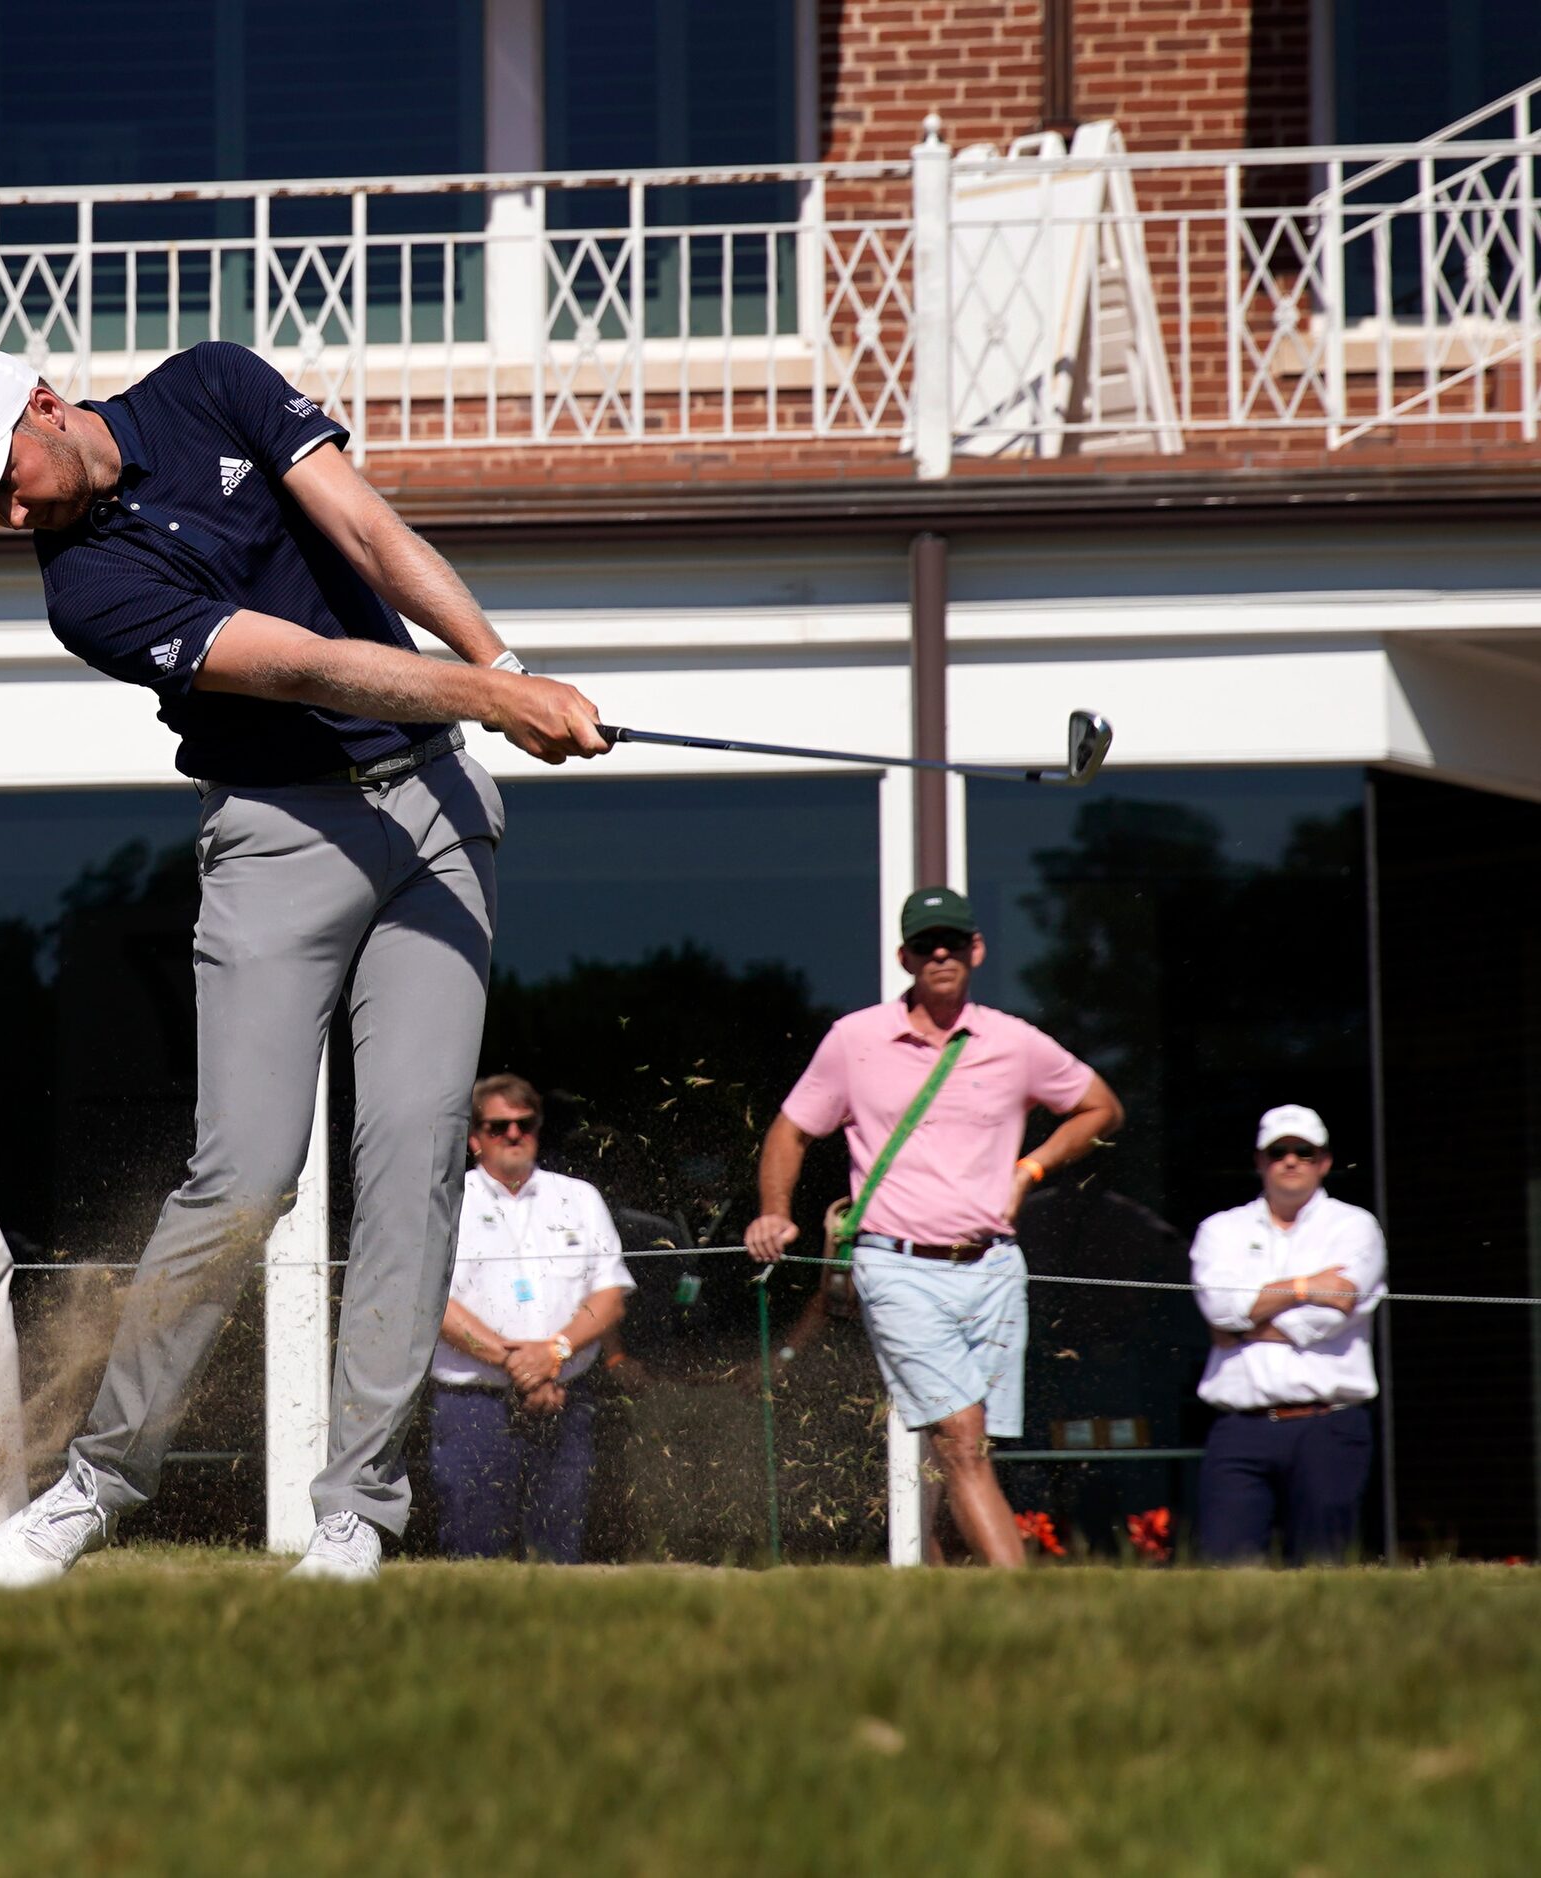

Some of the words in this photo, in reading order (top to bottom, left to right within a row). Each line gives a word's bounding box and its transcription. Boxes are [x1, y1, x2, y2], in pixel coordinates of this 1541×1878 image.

[283, 395, 317, 414] Ultim
[222, 459, 254, 496] adidas
[163, 638, 183, 671] didas
